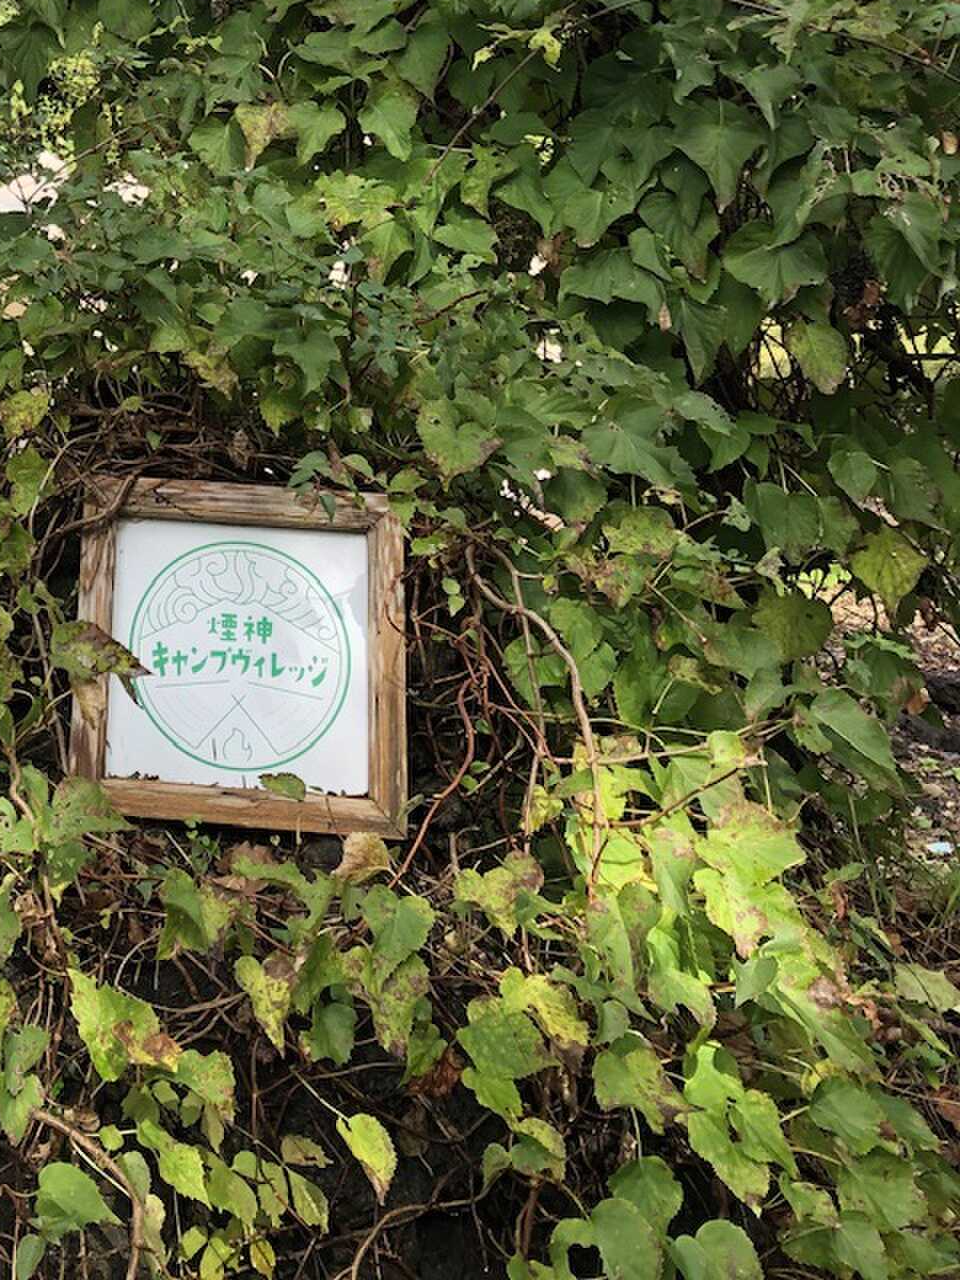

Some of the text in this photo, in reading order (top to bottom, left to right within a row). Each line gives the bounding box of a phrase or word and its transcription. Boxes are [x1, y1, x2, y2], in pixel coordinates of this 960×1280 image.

[207, 612, 273, 644] 煙神
[151, 641, 329, 688] キャンプヴィレッジ
